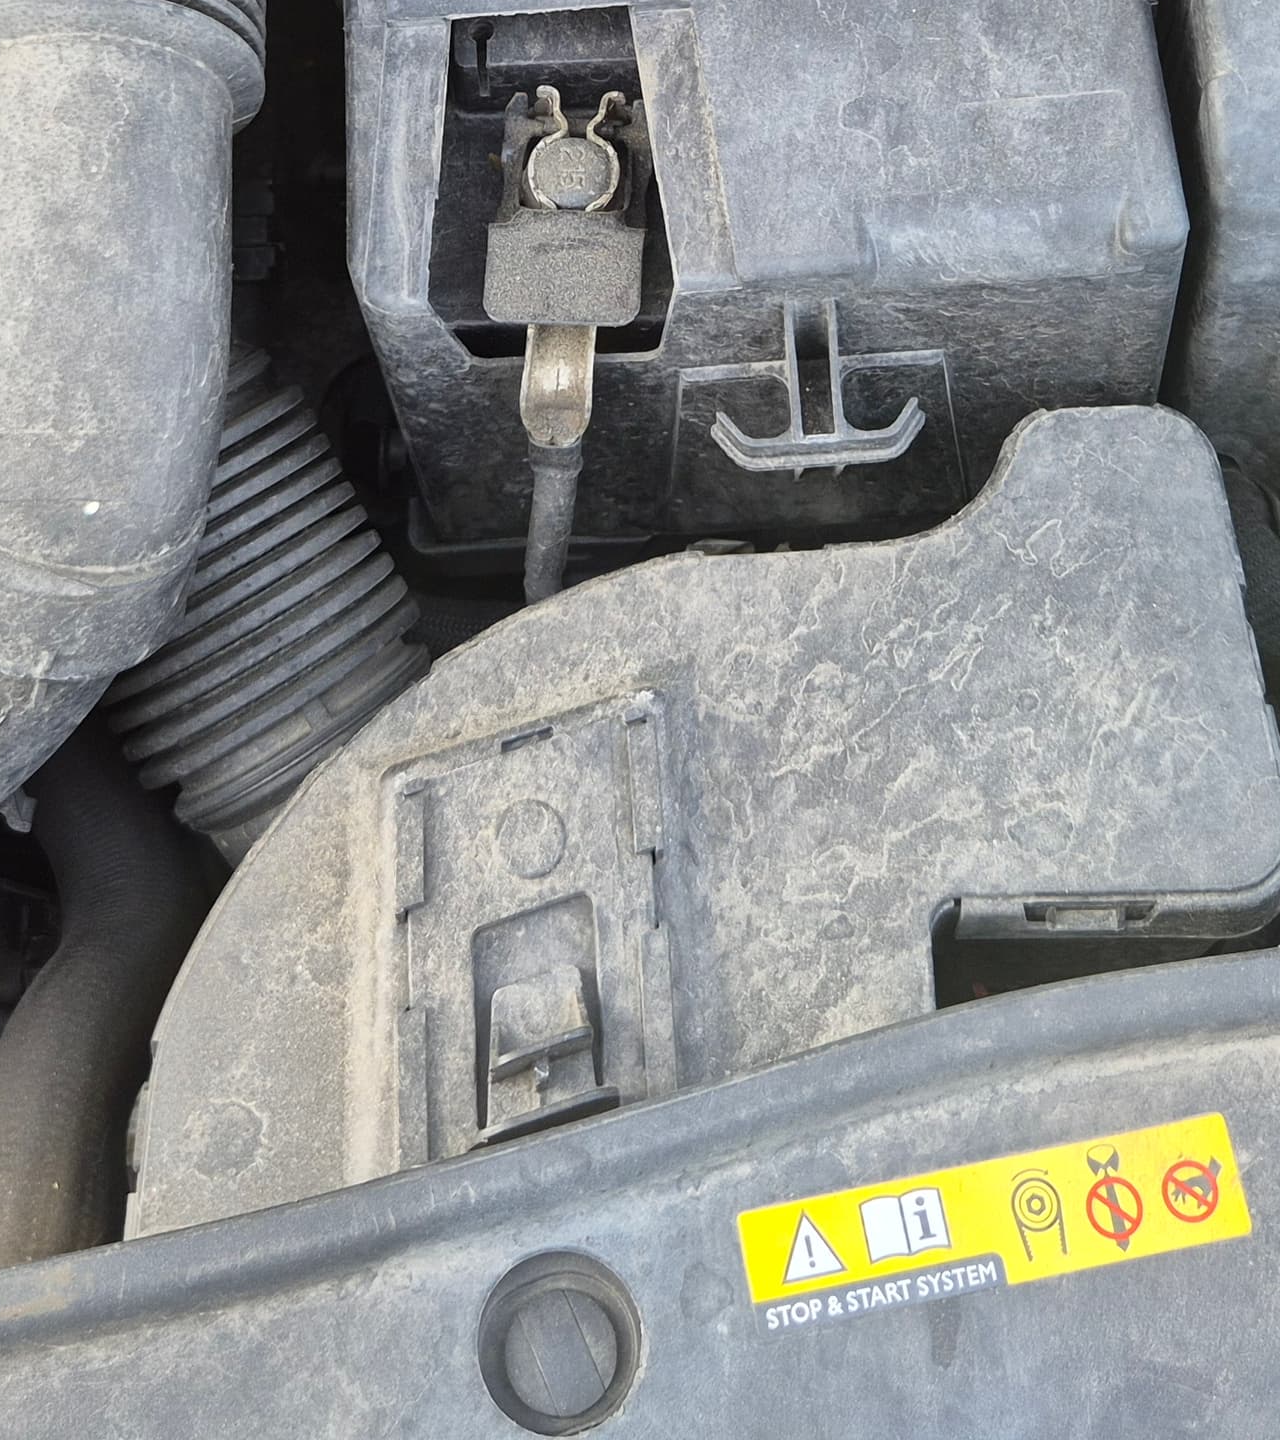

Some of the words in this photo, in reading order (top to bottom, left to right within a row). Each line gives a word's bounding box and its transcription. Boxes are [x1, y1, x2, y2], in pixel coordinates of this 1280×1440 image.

[766, 1299, 822, 1330] STOP
[827, 1295, 844, 1317] &
[845, 1278, 912, 1312] START
[916, 1260, 998, 1297] SYSTEM
